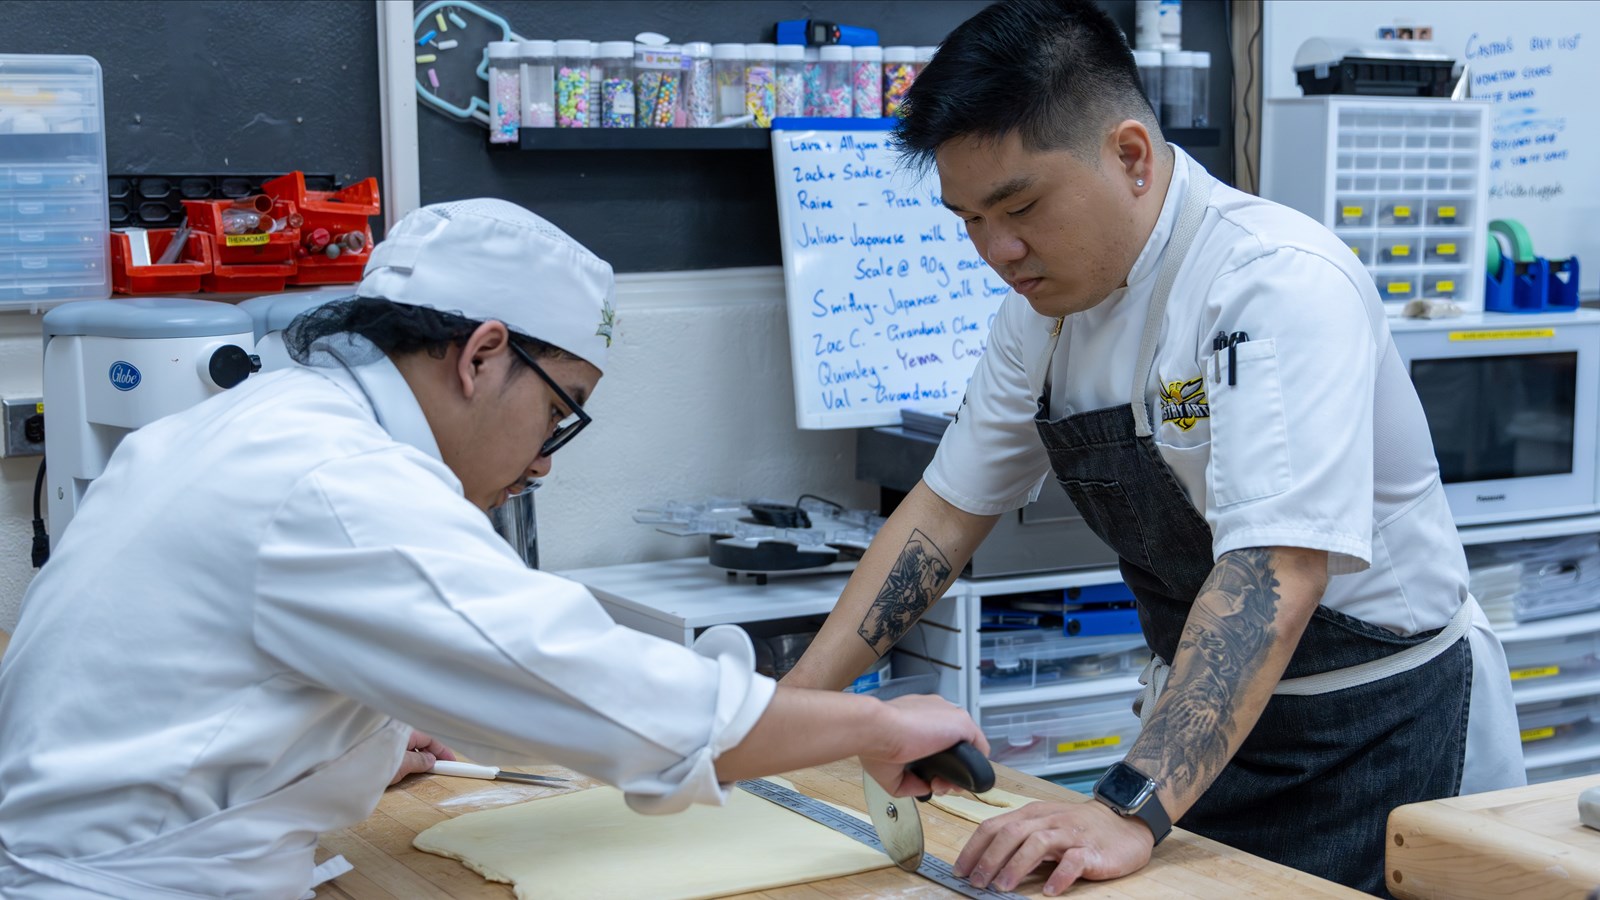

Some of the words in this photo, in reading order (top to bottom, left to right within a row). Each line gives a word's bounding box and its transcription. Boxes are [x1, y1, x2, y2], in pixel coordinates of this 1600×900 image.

[111, 364, 138, 385] Globe
[822, 388, 851, 410] Val
[1185, 403, 1210, 418] ART
